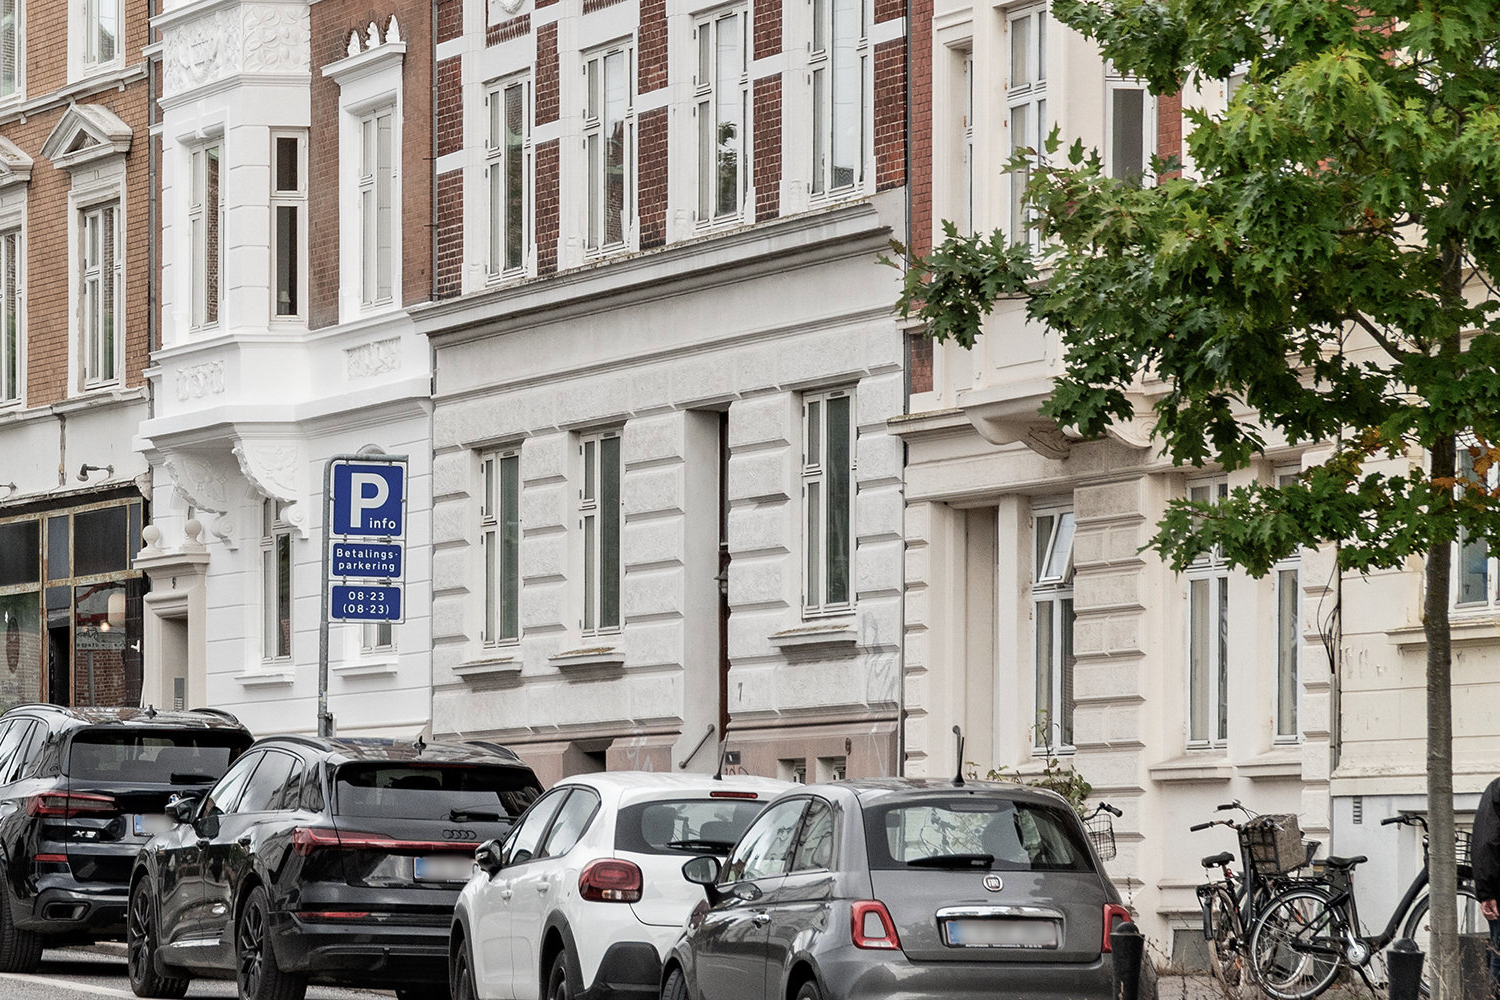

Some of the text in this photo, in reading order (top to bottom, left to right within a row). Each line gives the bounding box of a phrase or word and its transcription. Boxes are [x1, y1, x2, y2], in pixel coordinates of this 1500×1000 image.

[350, 472, 390, 528] P
[369, 517, 396, 530] info
[336, 548, 398, 561] Betalings-
[338, 561, 395, 573] parkering
[348, 591, 384, 601] 08-23
[342, 603, 389, 615] (08-23)
